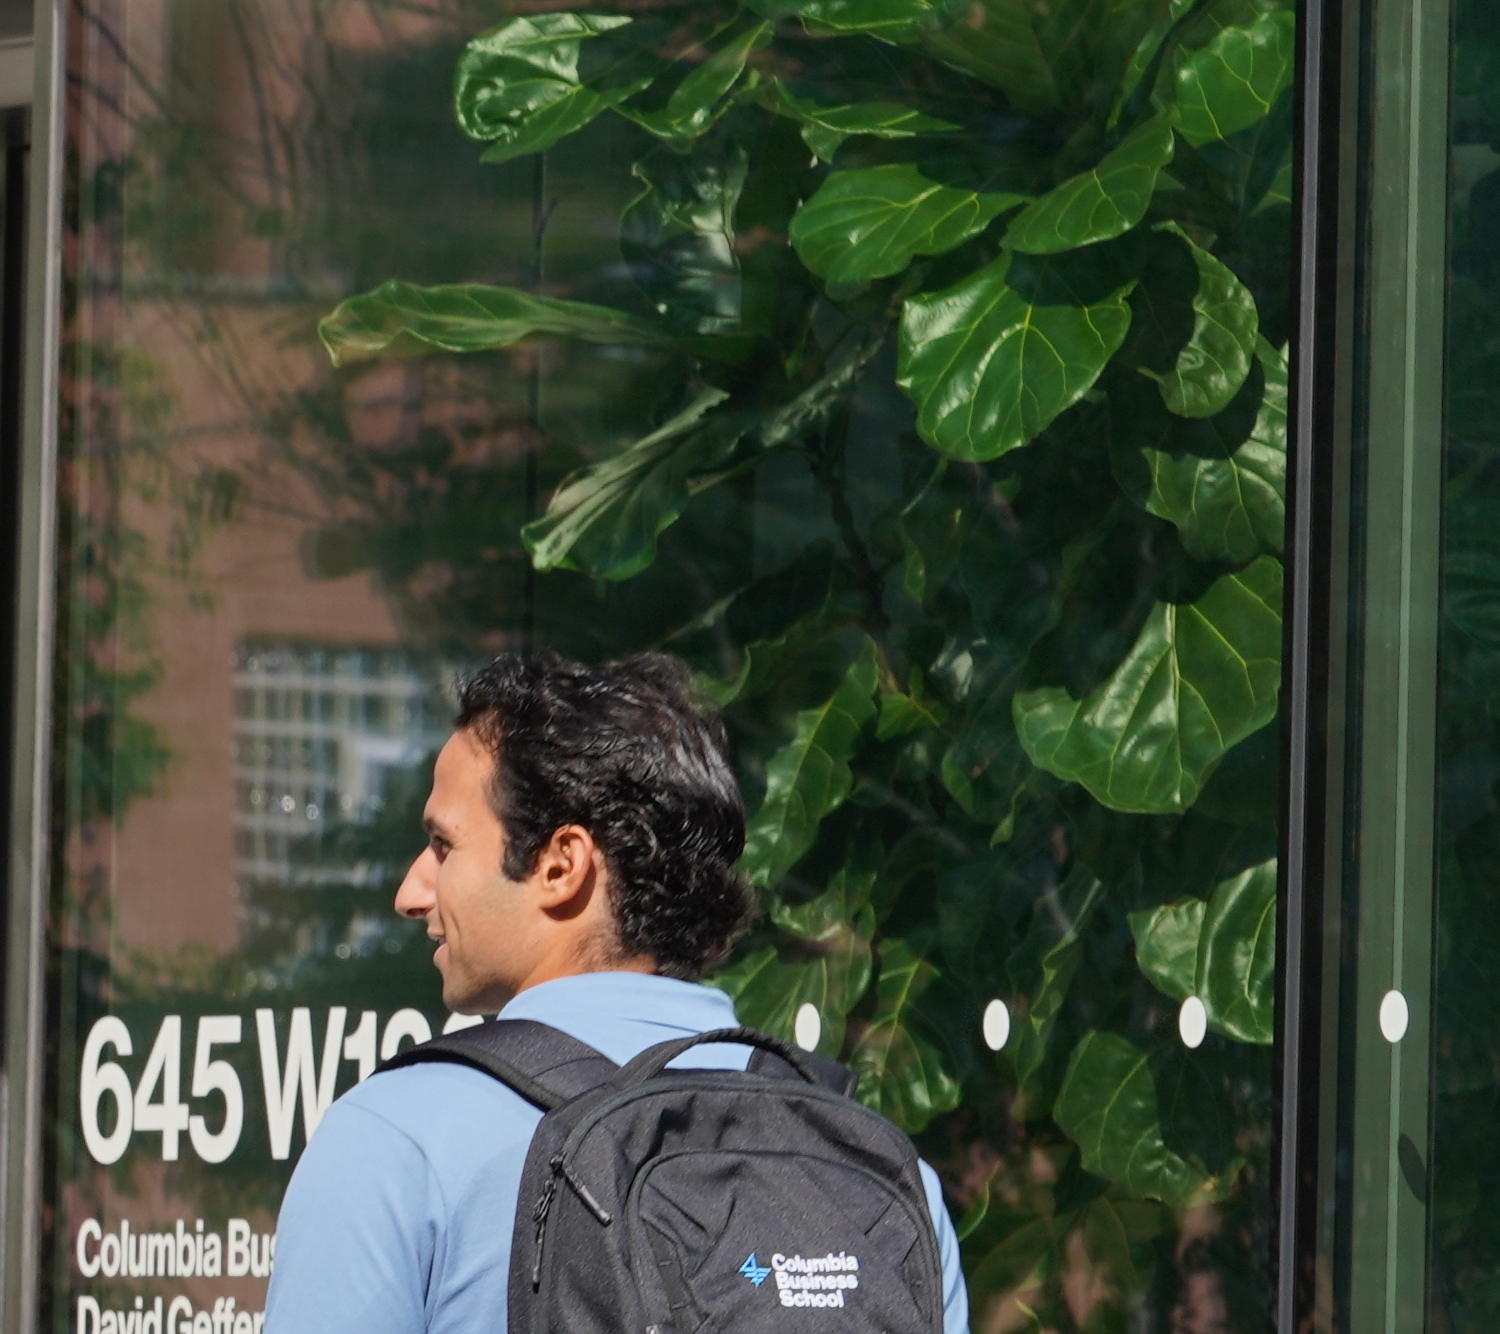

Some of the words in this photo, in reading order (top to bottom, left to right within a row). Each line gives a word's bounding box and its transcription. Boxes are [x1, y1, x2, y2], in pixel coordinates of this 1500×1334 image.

[79, 1013, 245, 1165] 645
[76, 1218, 222, 1279] Columbia
[771, 1251, 859, 1272] Columbia
[775, 1271, 858, 1290] Business
[779, 1289, 844, 1308] School
